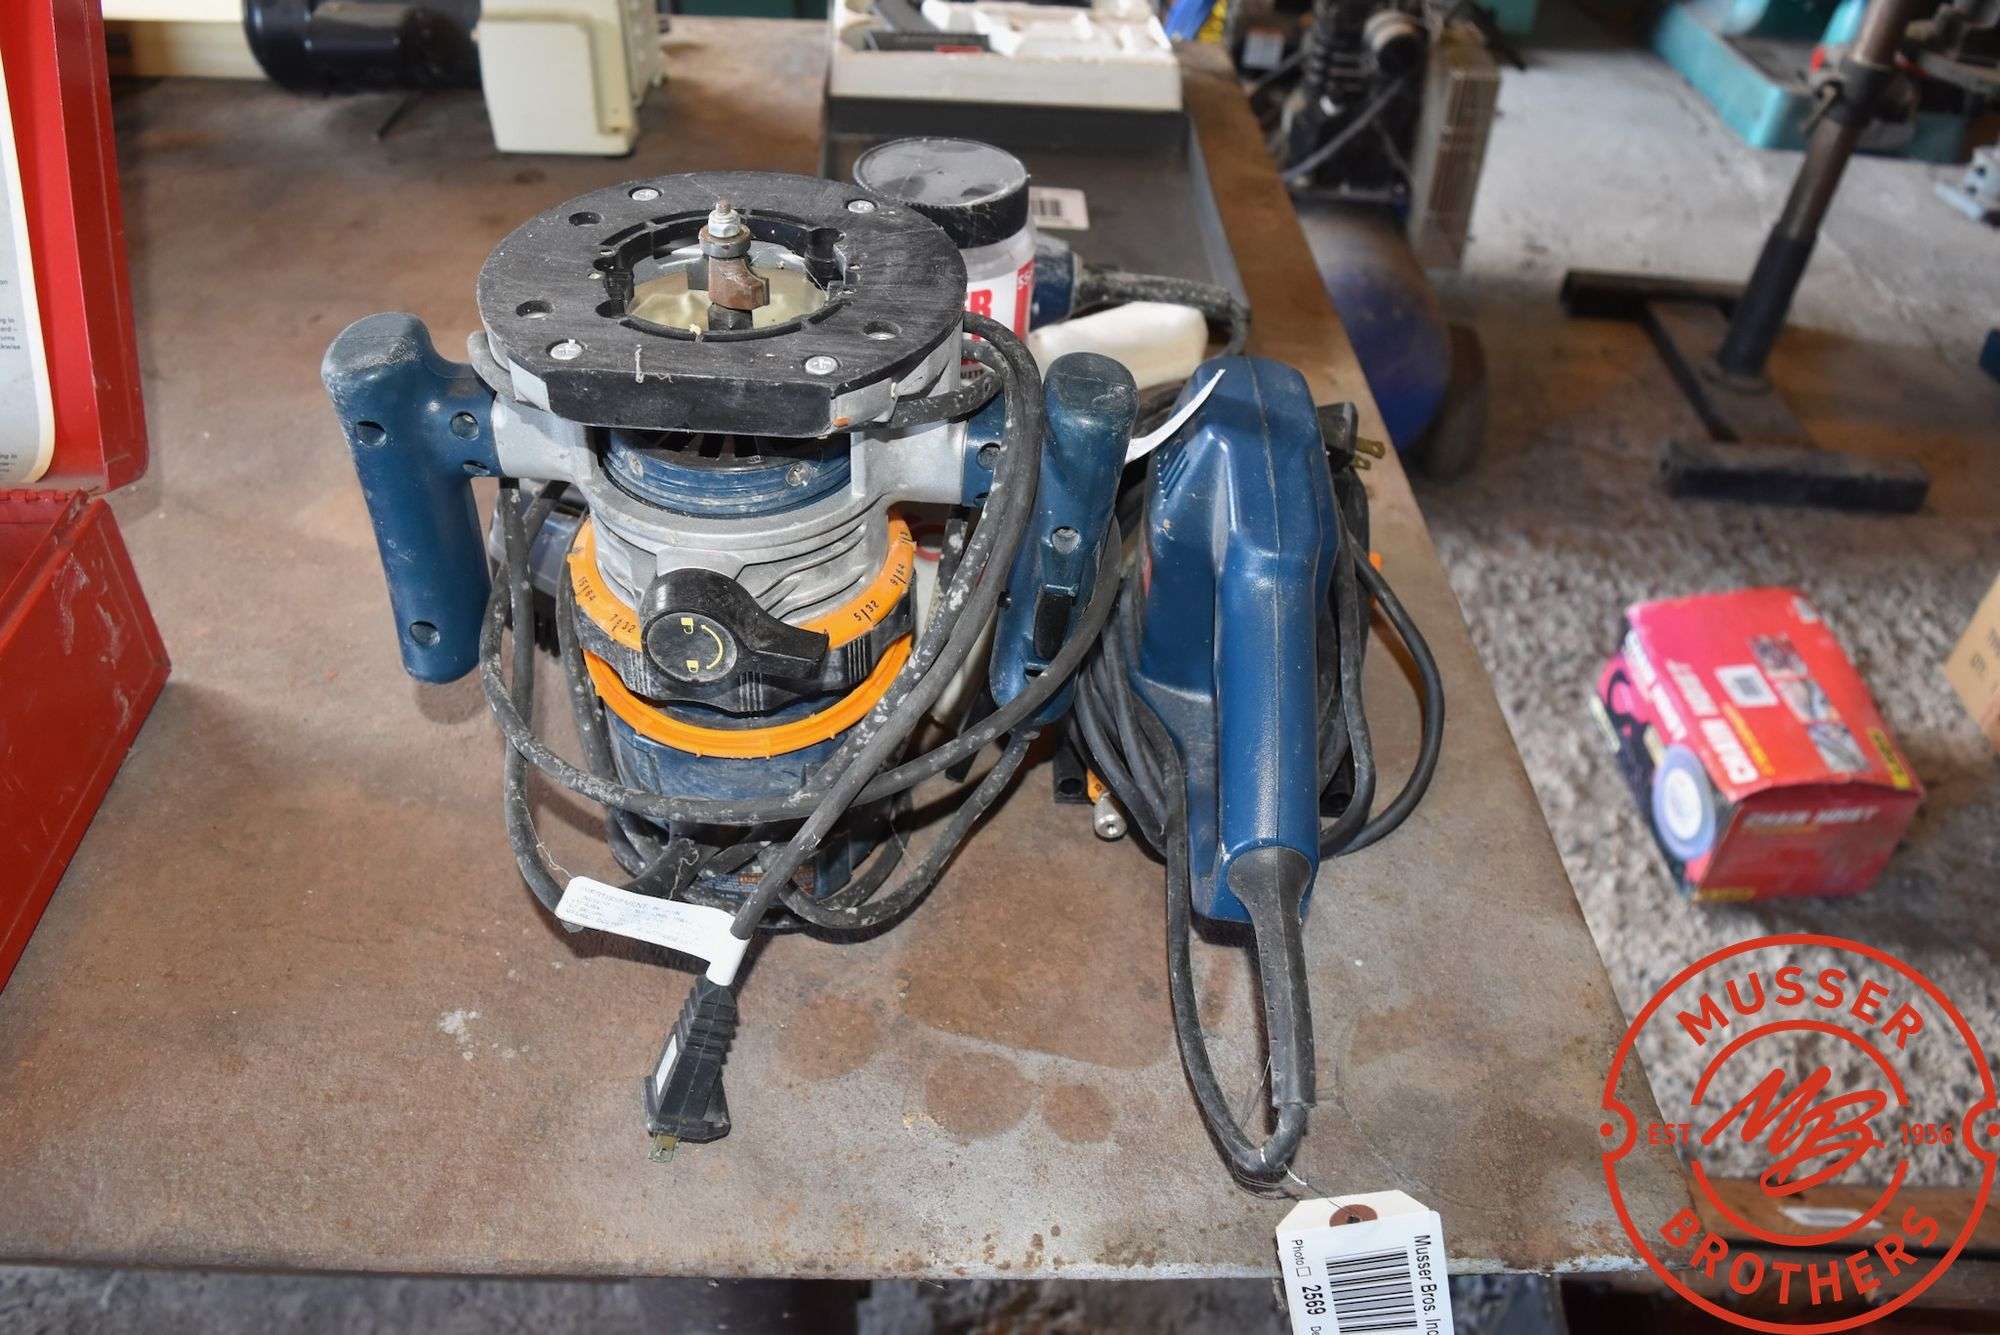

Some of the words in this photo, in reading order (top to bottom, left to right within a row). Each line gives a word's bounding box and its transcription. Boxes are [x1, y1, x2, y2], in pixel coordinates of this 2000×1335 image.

[853, 600, 879, 622] 5/32
[1292, 1239, 1305, 1265] Photo
[1302, 1284, 1326, 1315] 2569
[1414, 1235, 1432, 1281] Musser
[1421, 1283, 1438, 1316] Bros.
